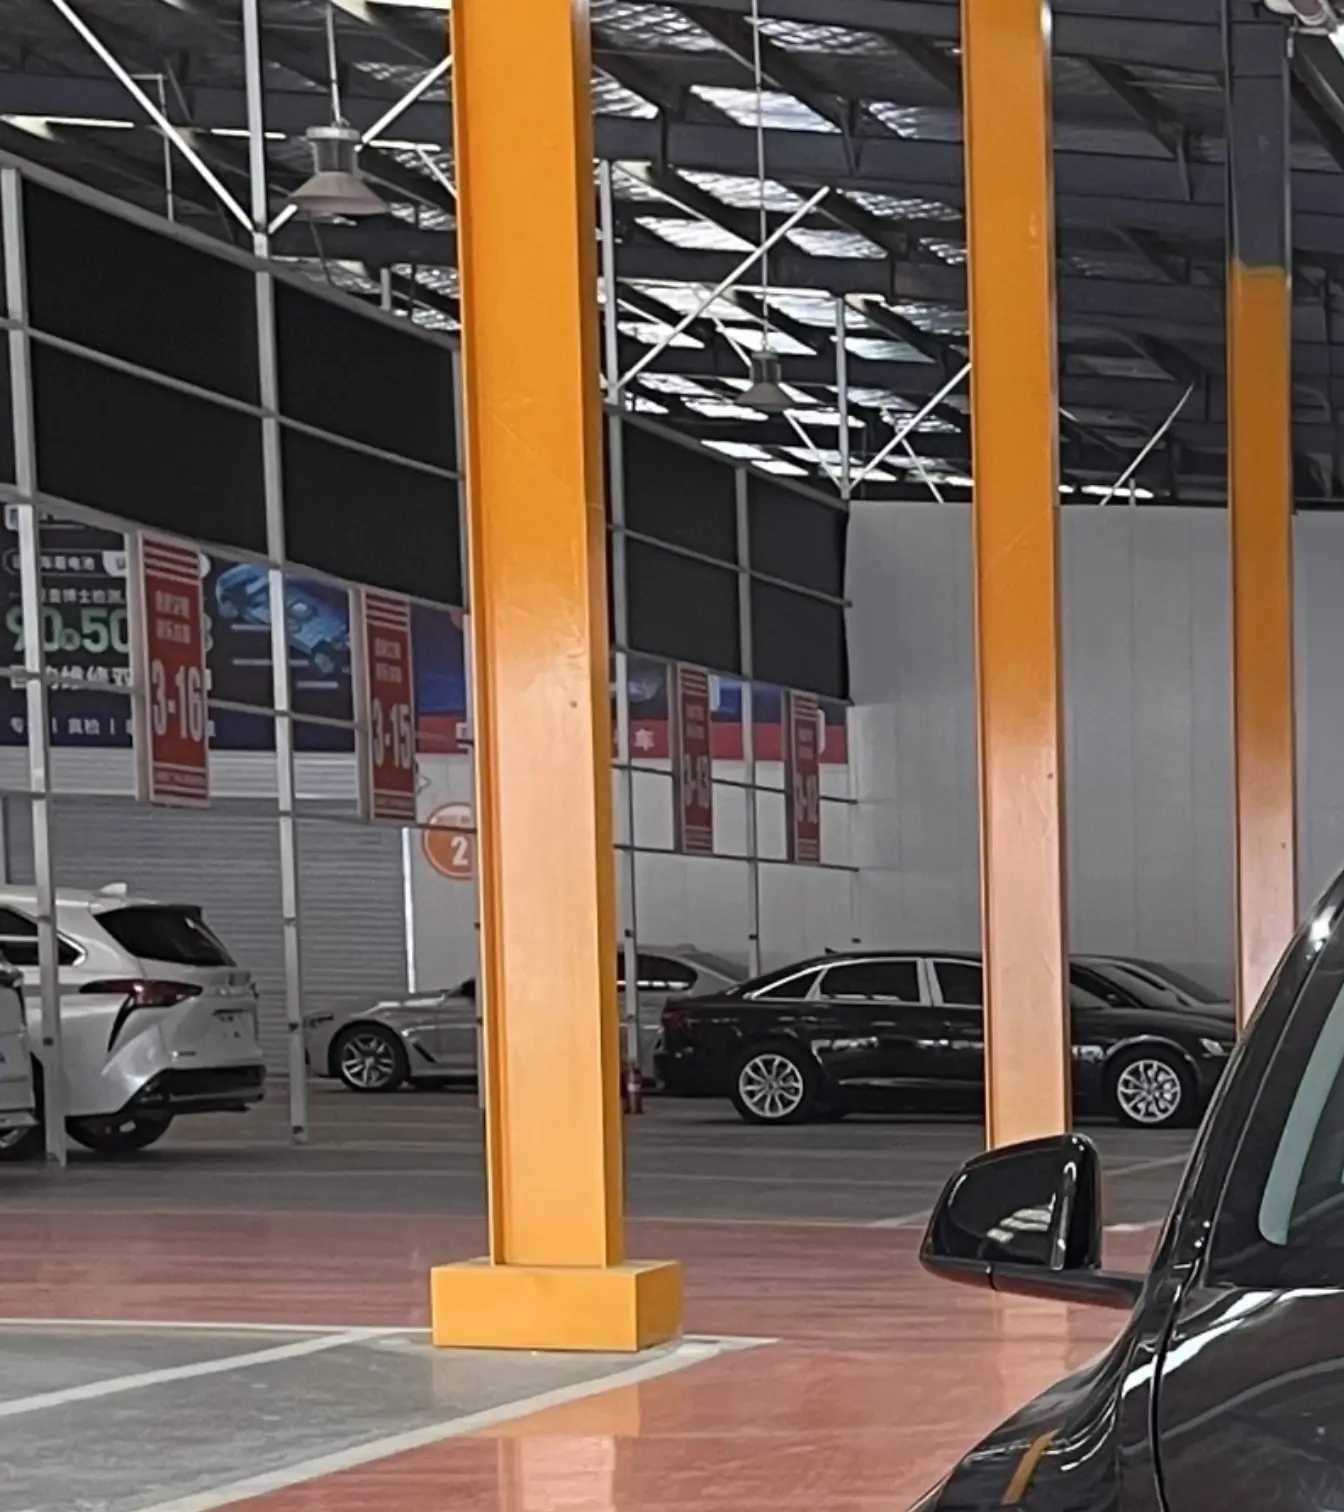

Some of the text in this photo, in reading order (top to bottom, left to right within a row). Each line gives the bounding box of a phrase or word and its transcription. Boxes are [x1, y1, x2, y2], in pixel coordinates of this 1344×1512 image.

[152, 659, 204, 742] 3-16
[371, 698, 412, 769] 3-15
[450, 836, 469, 865] 2
